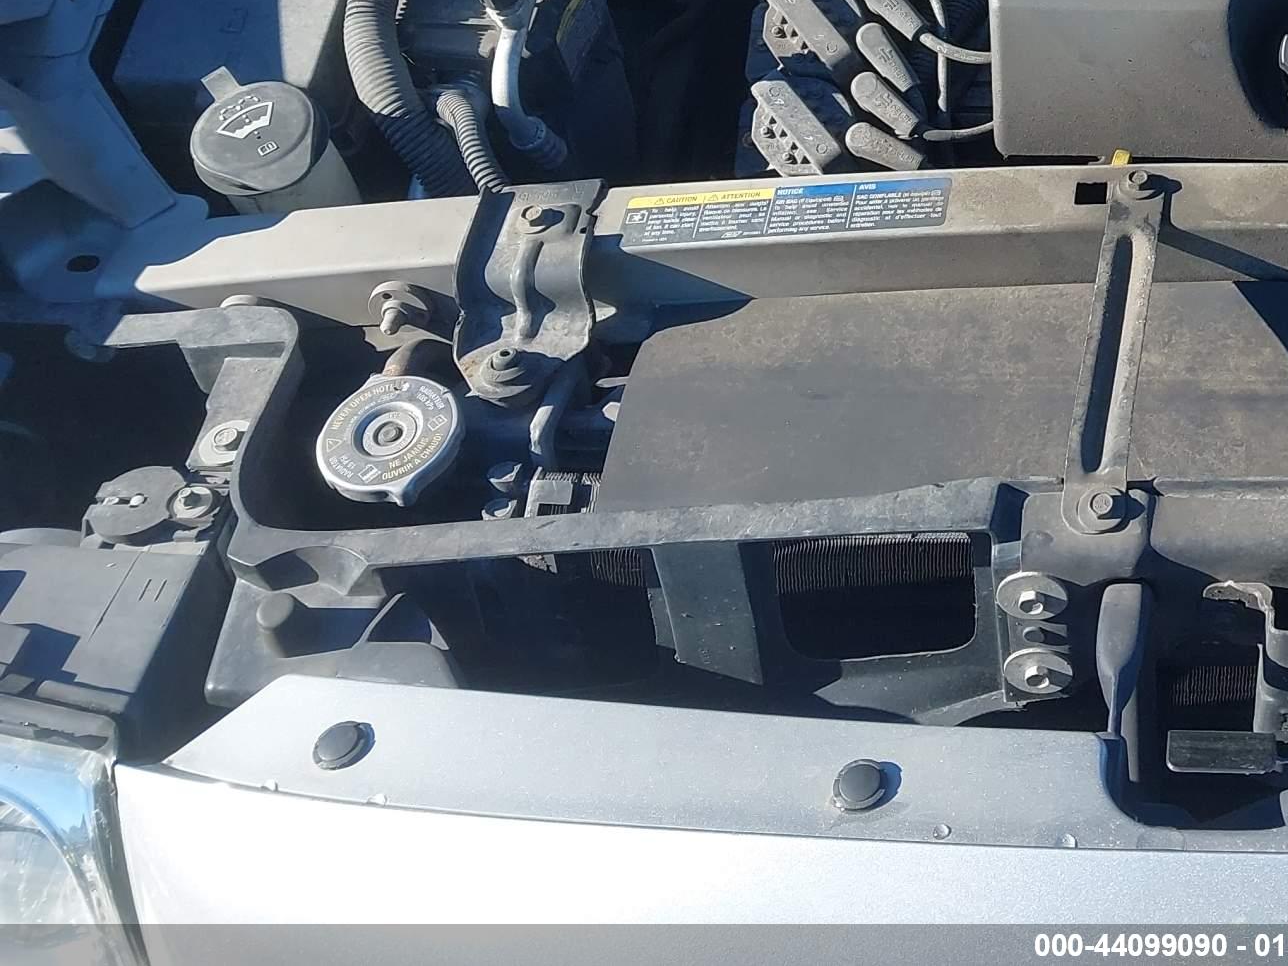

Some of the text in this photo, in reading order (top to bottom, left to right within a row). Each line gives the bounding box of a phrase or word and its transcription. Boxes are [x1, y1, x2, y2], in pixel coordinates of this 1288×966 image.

[667, 196, 698, 204] CAUTION
[720, 191, 760, 200] ATTENTION
[388, 436, 428, 470] NE JAMAIS
[382, 464, 414, 481] OUVRIR
